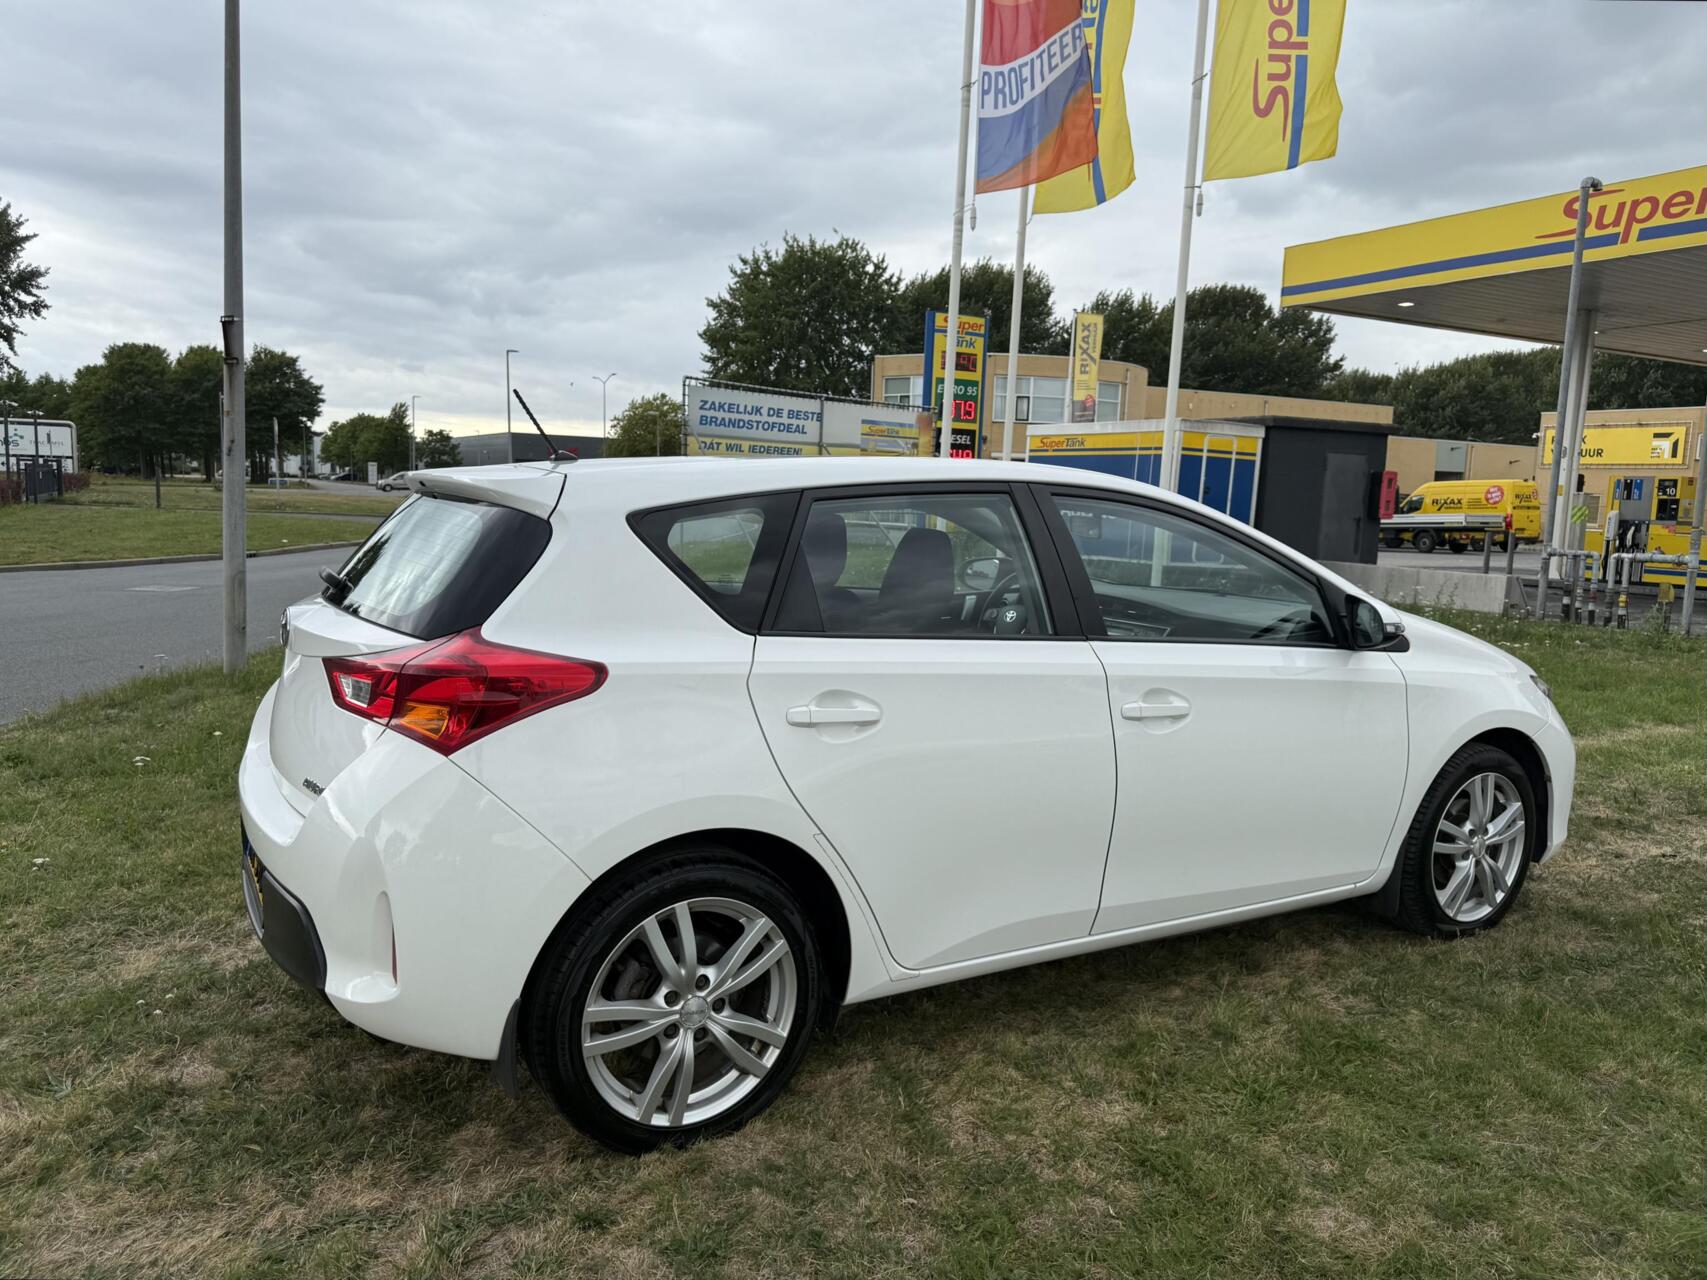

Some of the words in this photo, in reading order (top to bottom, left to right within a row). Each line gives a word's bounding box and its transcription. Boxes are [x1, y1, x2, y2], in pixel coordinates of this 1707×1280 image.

[981, 22, 1082, 109] PROFITEER
[1079, 322, 1096, 375] RIXAX
[937, 384, 965, 394] ERO
[967, 386, 978, 396] 95
[699, 400, 763, 416] ZAKELIJK
[767, 407, 784, 418] DE
[787, 409, 822, 422] BESTE
[699, 415, 807, 435] BRANDSTOFDEAL
[725, 442, 744, 453] WIL
[748, 444, 803, 455] IEDEREEN!
[1666, 488, 1676, 496] 10
